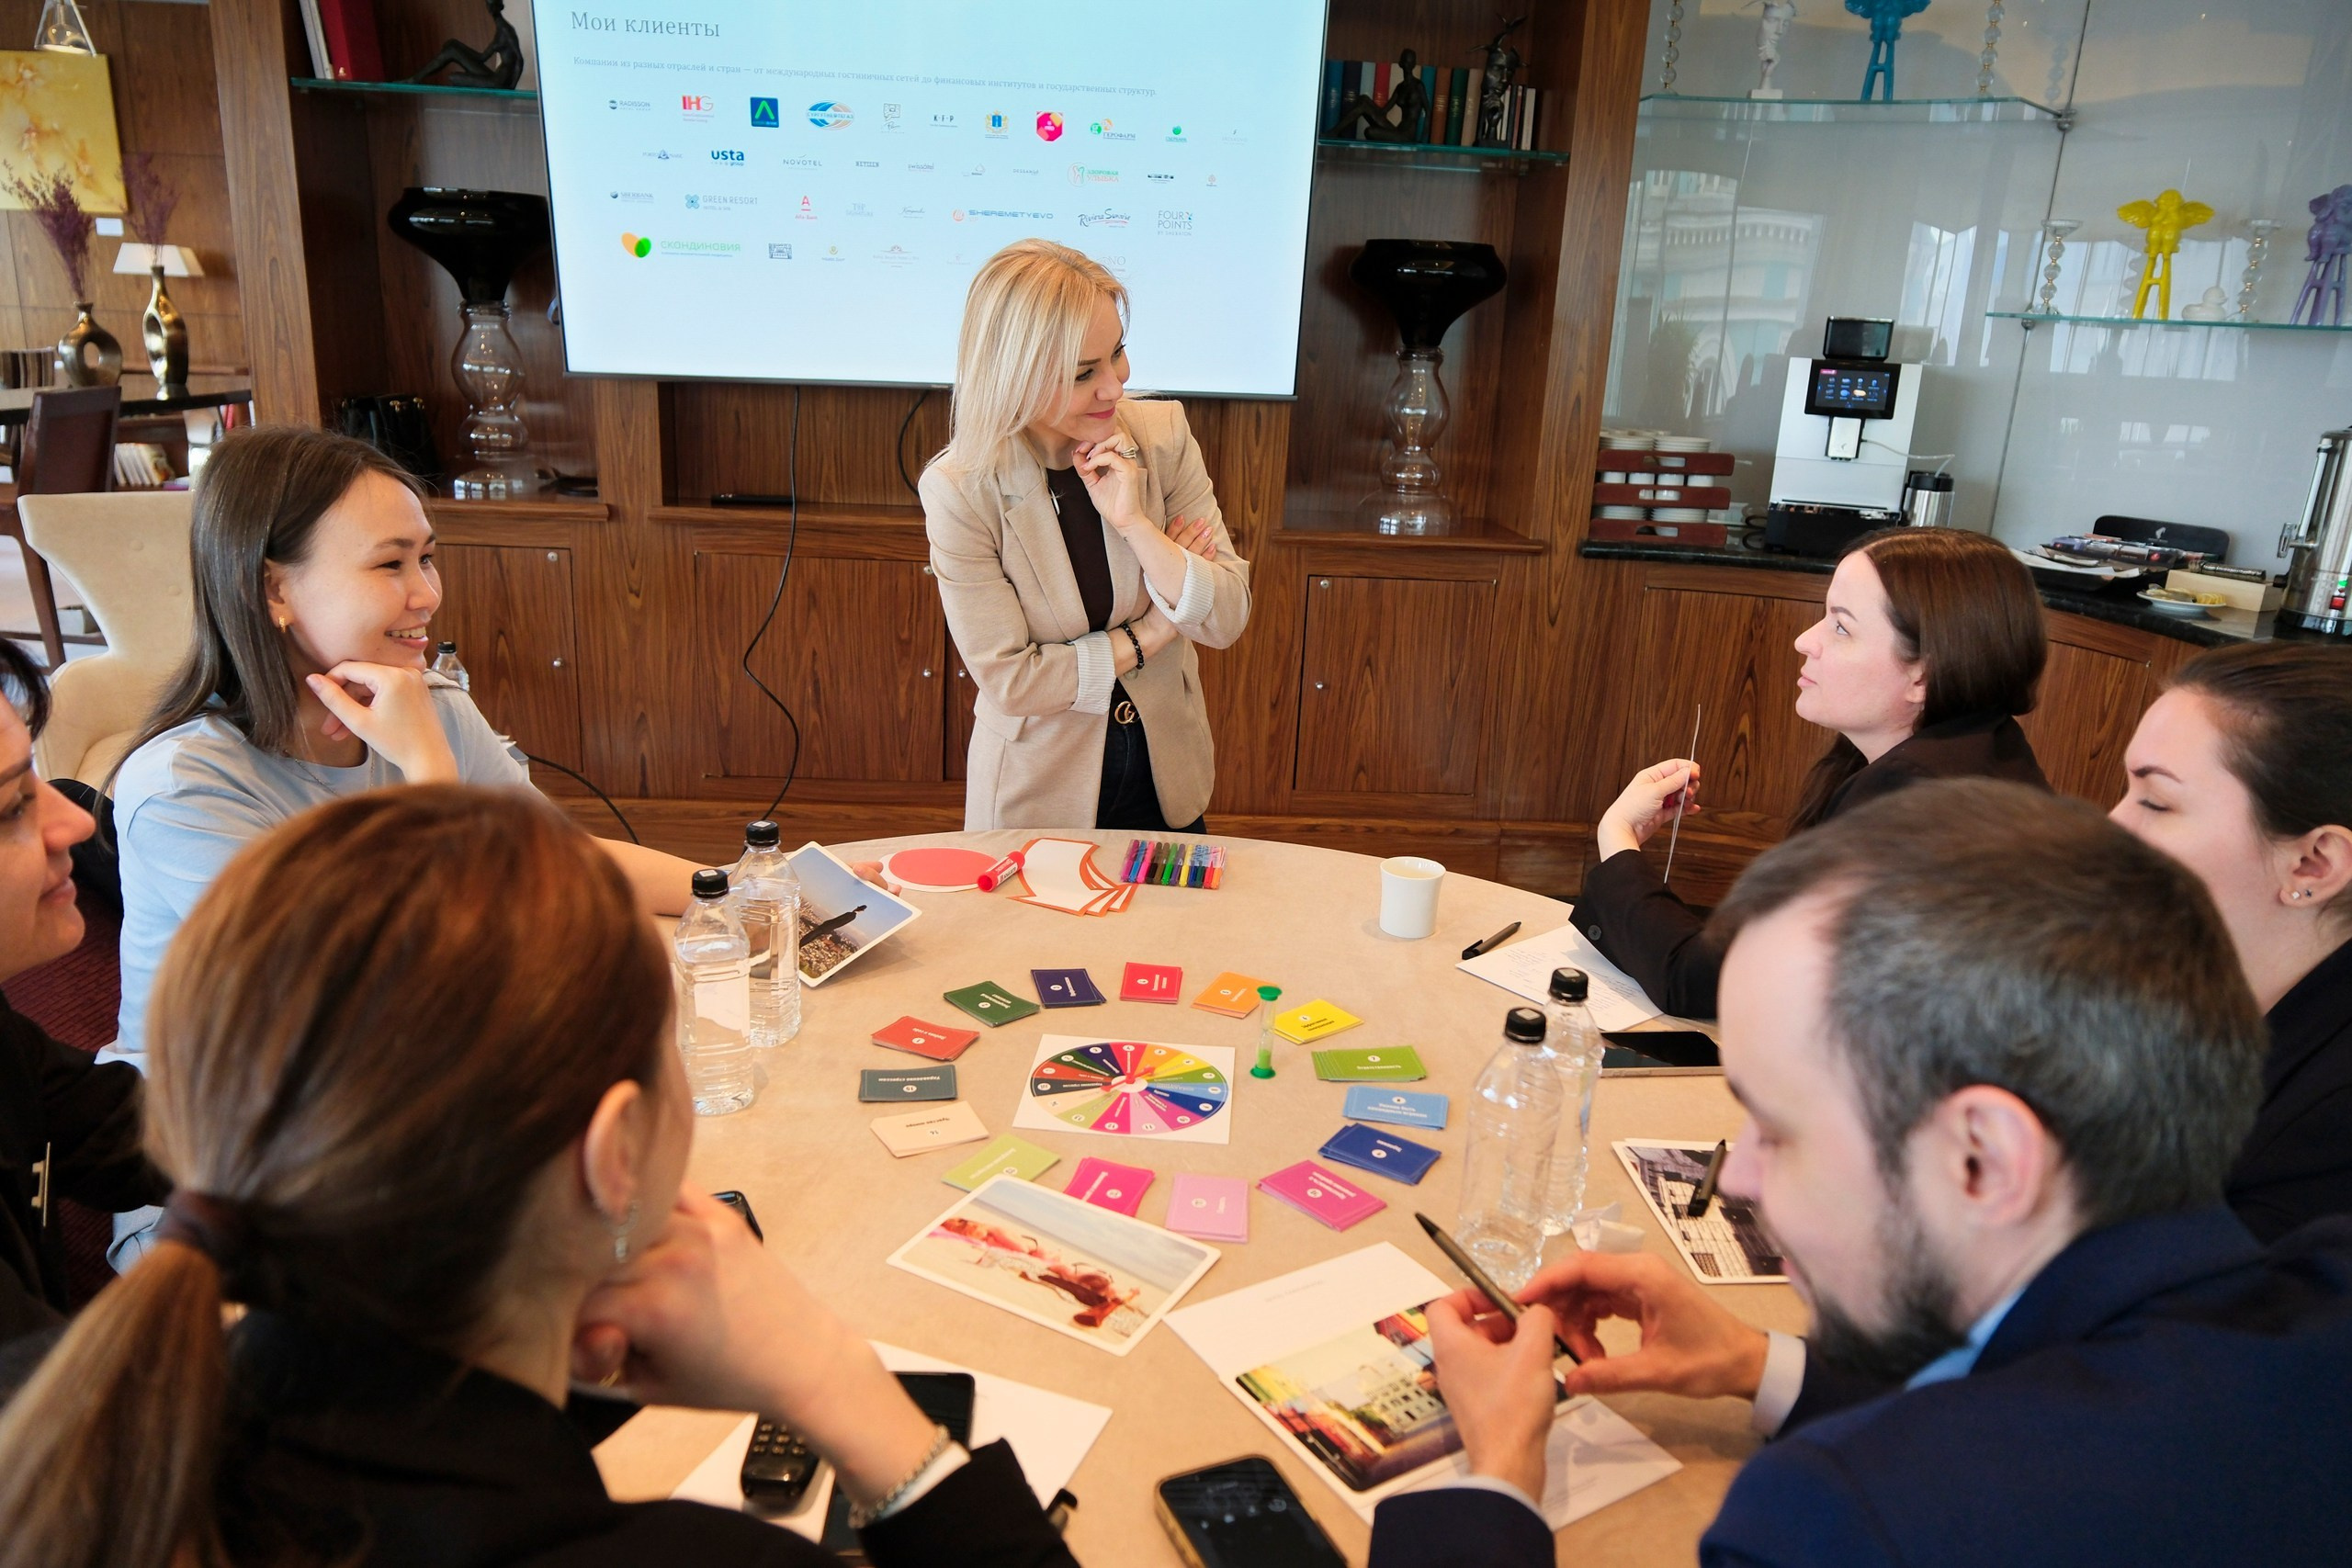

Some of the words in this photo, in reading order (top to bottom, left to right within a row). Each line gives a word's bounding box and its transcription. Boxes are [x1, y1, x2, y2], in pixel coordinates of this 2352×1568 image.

[571, 11, 616, 31] Мои
[625, 18, 720, 37] клиенты
[573, 56, 618, 67] Компании
[620, 60, 631, 68] из
[633, 61, 665, 71] разных
[667, 62, 707, 73] отраслей
[717, 65, 741, 74] стран
[765, 68, 836, 79] международных
[837, 72, 895, 82] гостиничных
[896, 74, 919, 85] сетей
[922, 76, 932, 85] до
[933, 73, 986, 86] финансовых
[988, 80, 1036, 90] институтов
[1046, 84, 1116, 95] государственных
[682, 95, 714, 112] IHG
[710, 149, 745, 162] usta
[783, 158, 823, 167] NOVOTEL
[702, 194, 728, 204] GREEN
[729, 196, 758, 206] RESORT
[968, 209, 1054, 220] SHEREMETYEVO
[1158, 210, 1183, 220] FOUR
[1158, 220, 1193, 231] POINTS
